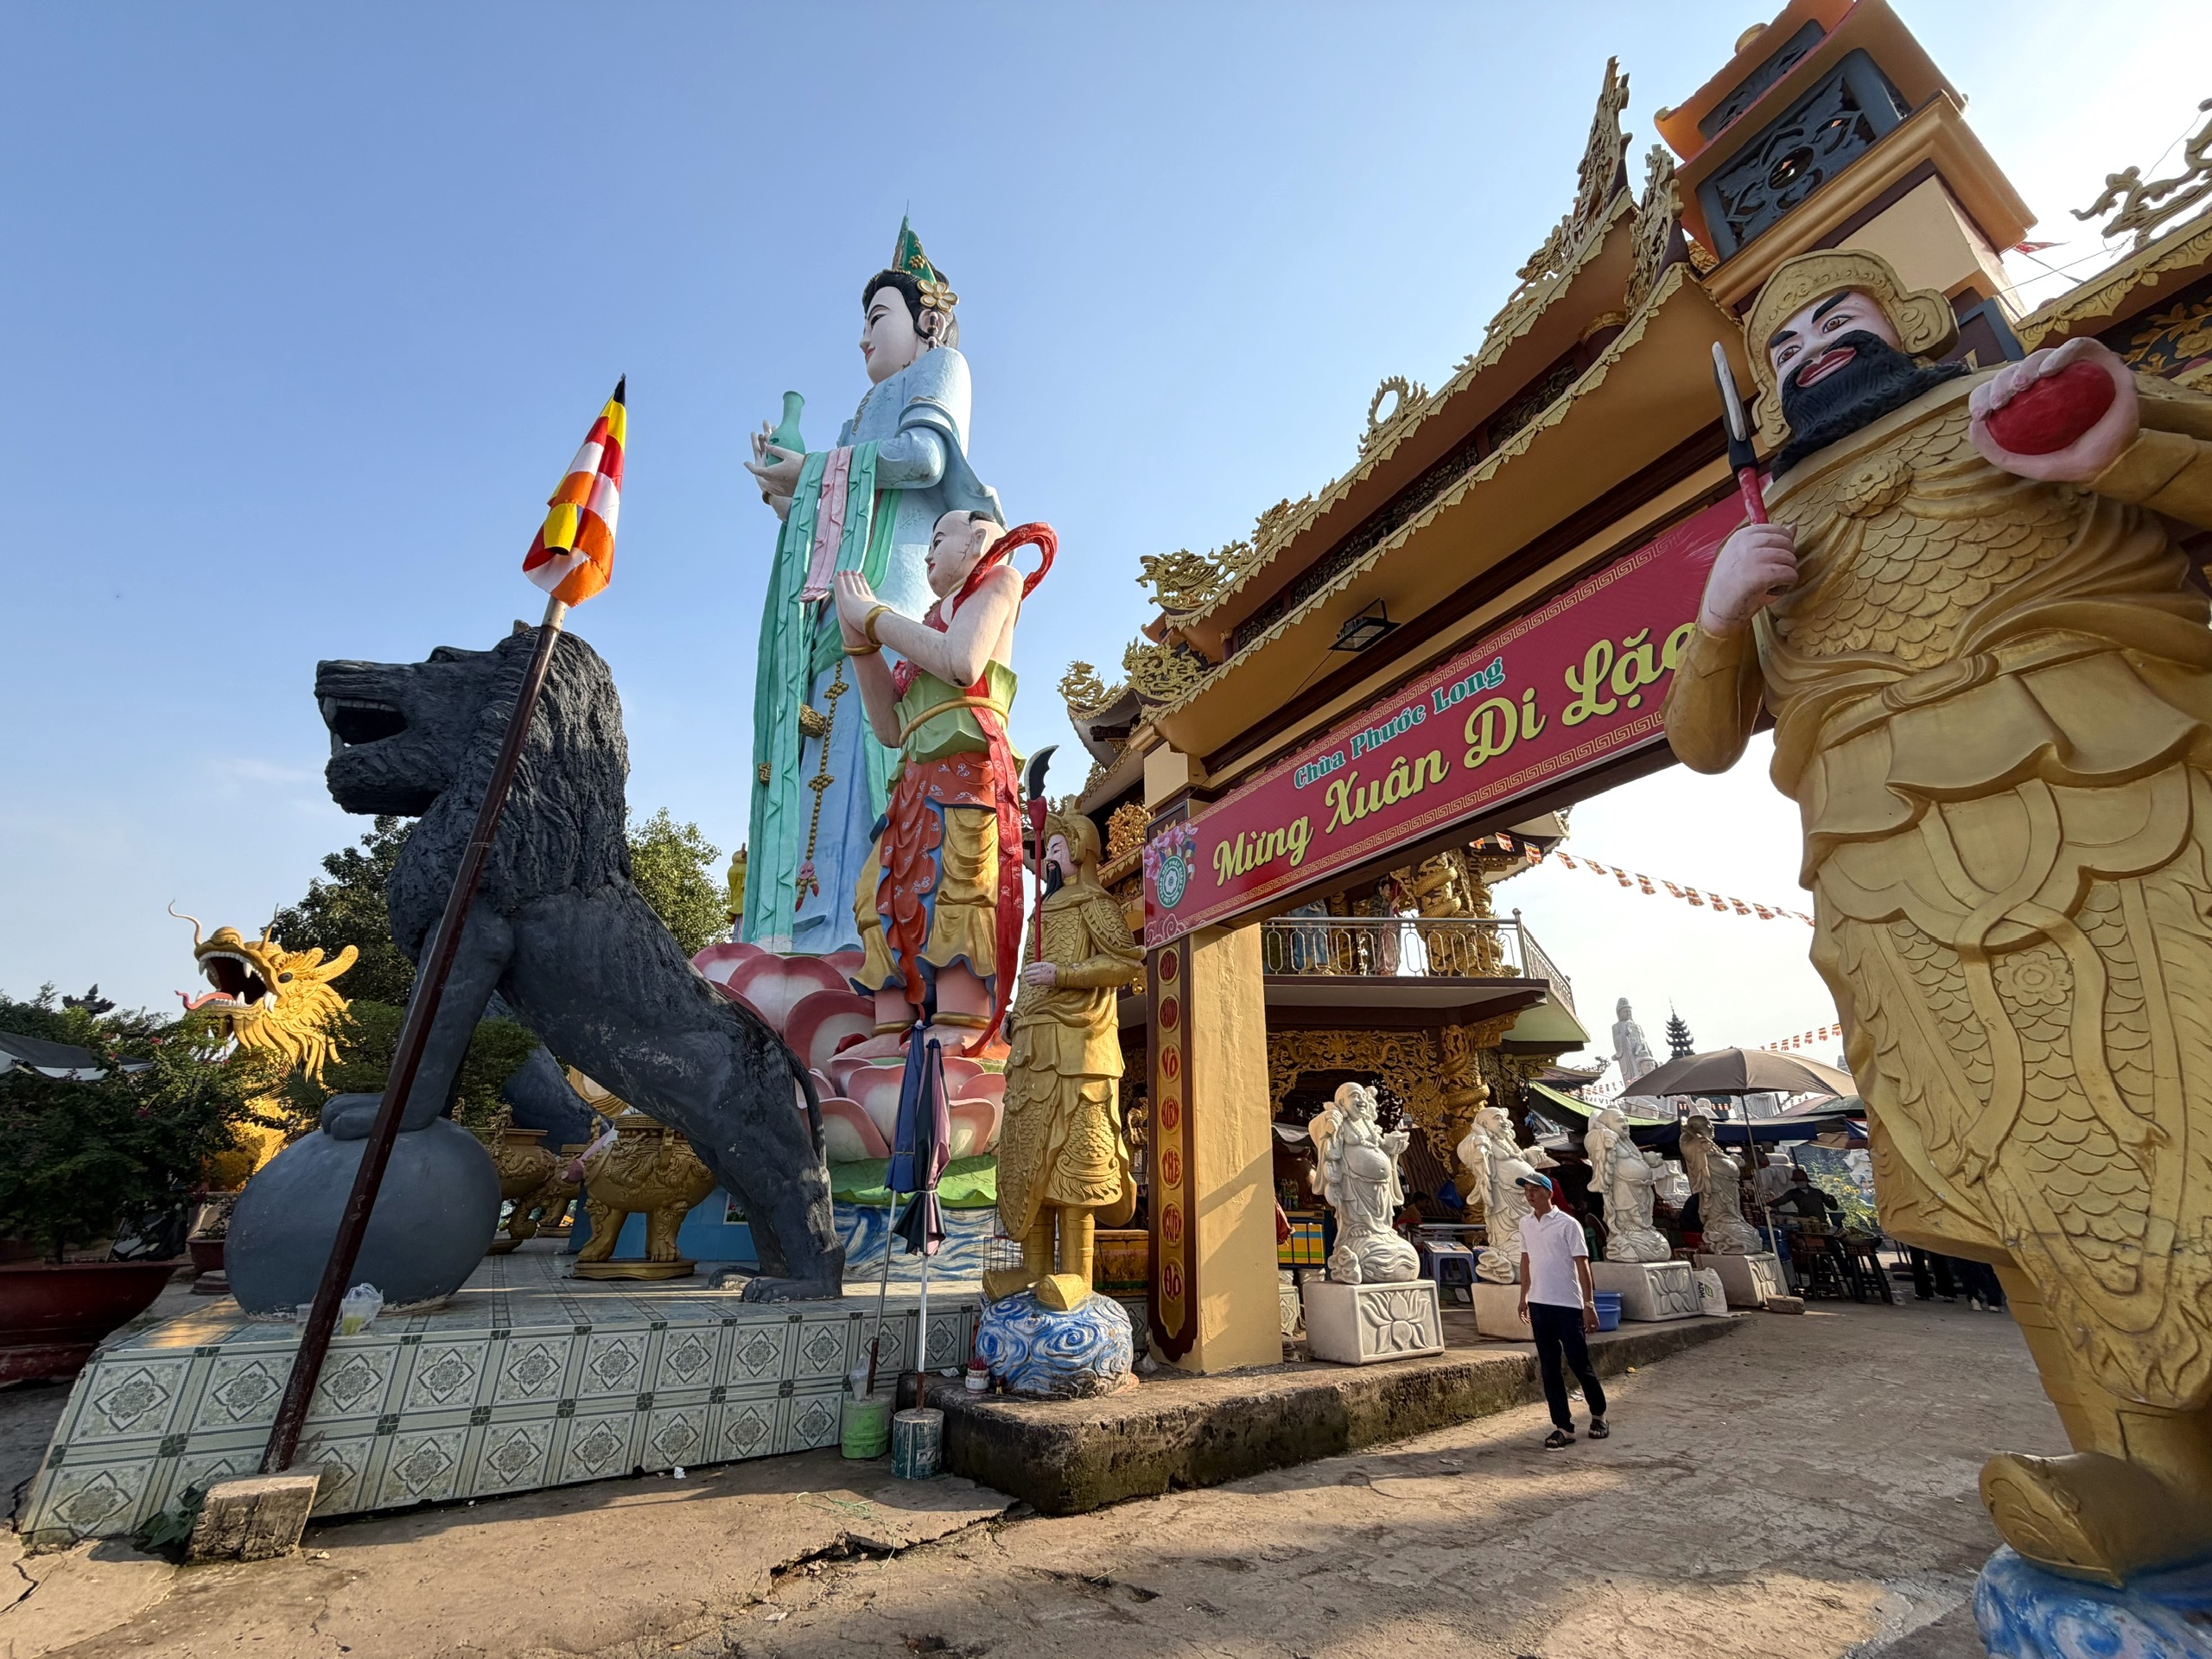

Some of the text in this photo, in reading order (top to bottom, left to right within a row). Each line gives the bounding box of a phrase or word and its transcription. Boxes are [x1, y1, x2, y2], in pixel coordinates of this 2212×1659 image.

[1294, 657, 1505, 789] Chùa Phước Long
[1212, 815, 1313, 887] Mừng
[1325, 749, 1450, 834] Xuân
[1463, 687, 1547, 768] Di
[1161, 1046, 1179, 1078] VÔ
[1697, 1281, 1706, 1299] ADM
